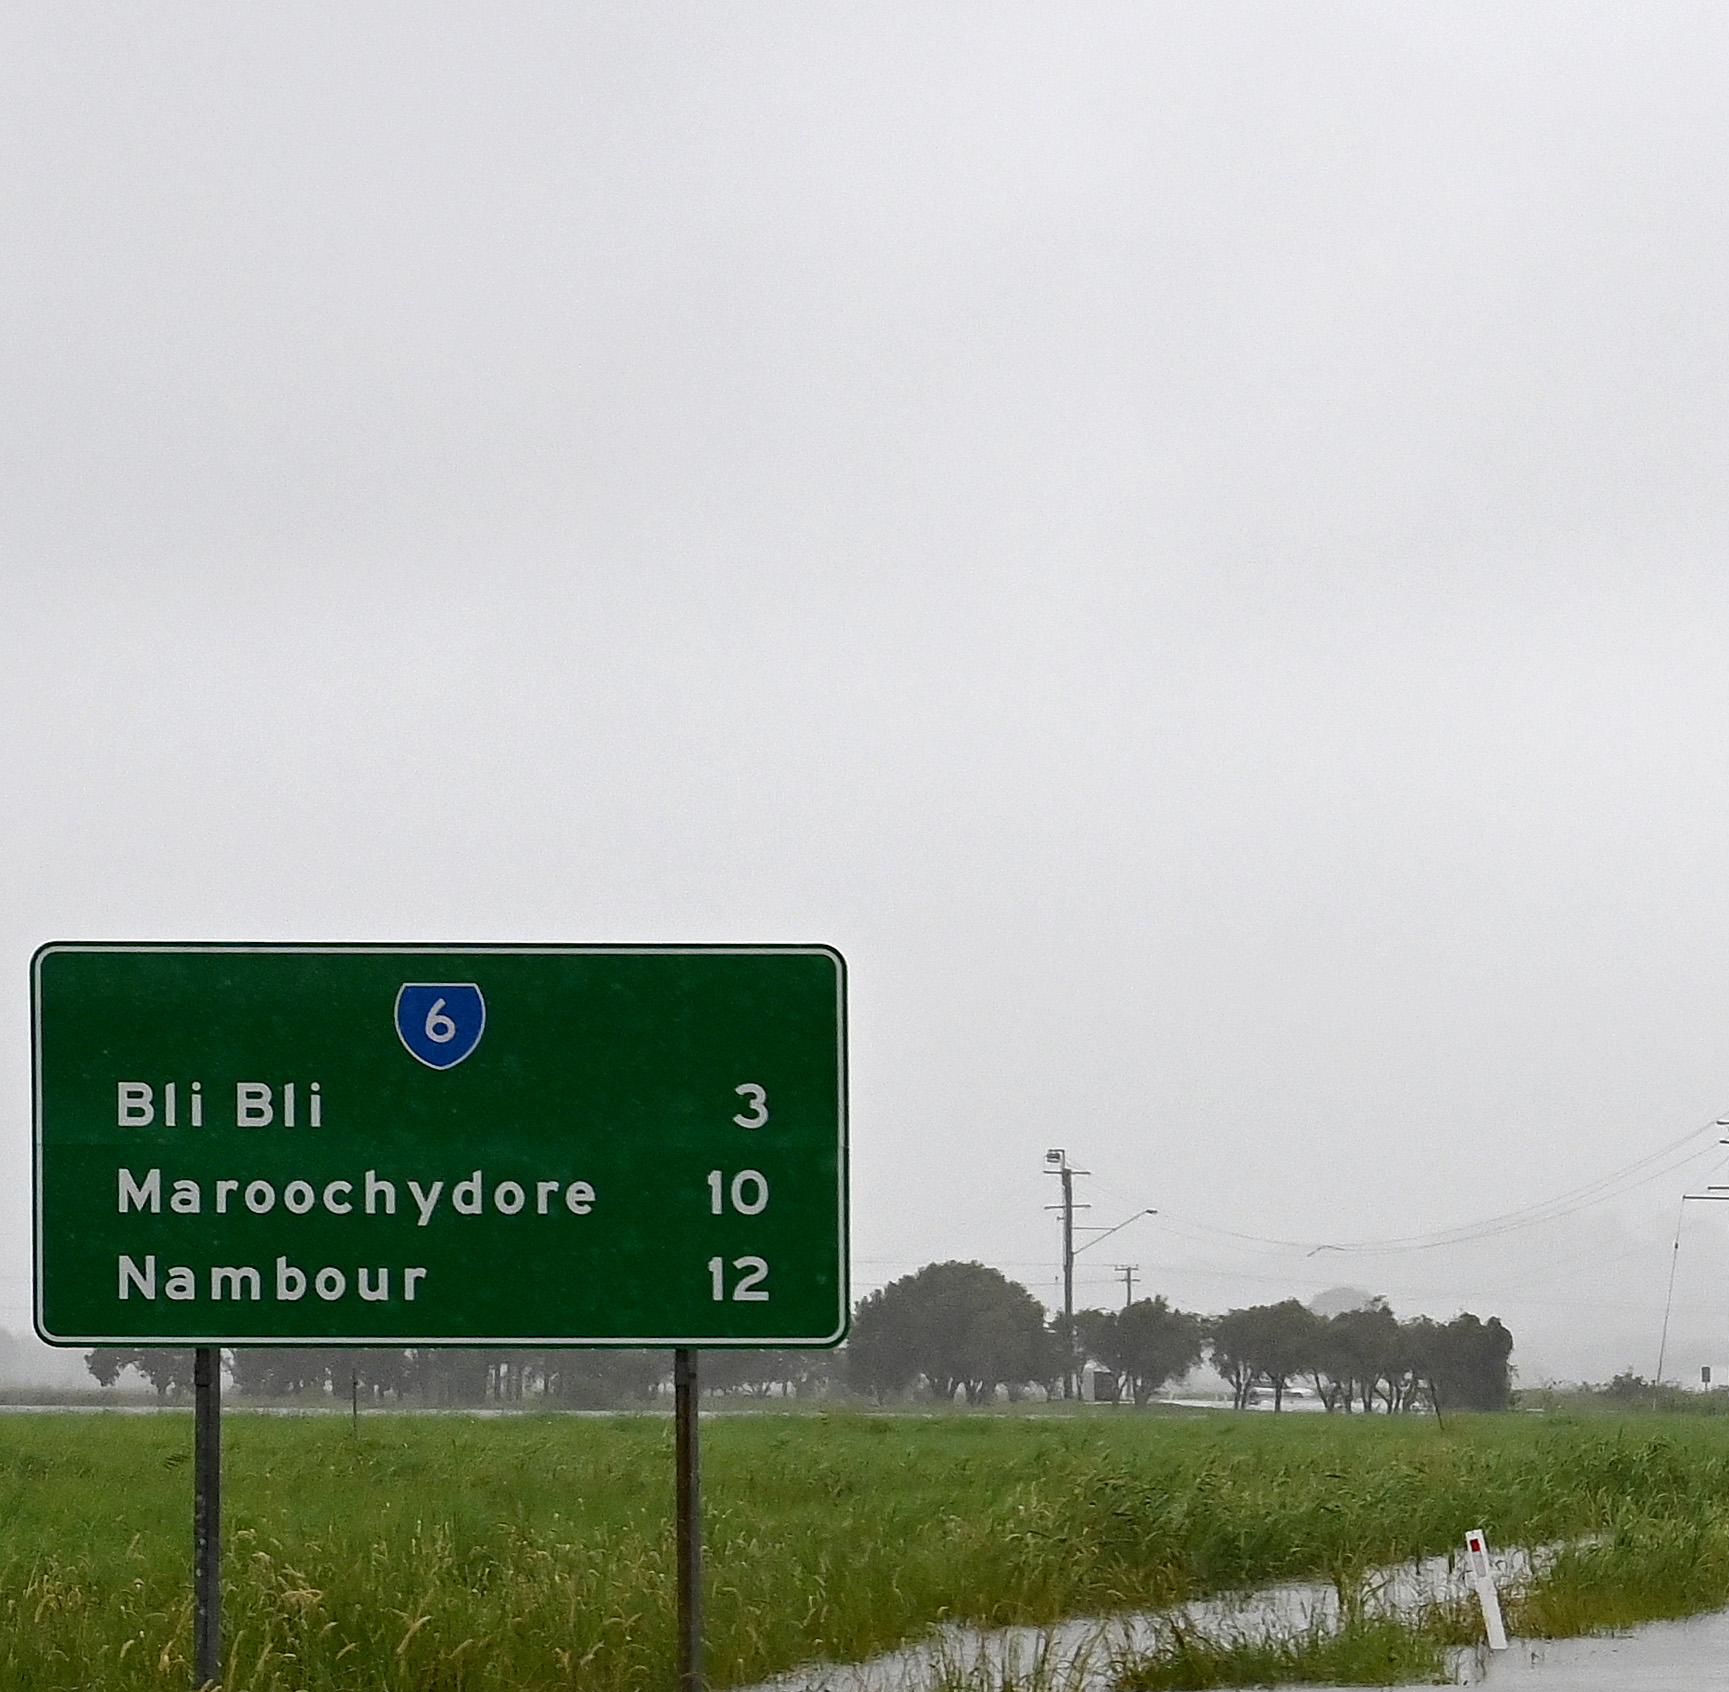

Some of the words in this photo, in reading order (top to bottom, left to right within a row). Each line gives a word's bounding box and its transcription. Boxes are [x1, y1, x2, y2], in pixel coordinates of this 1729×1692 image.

[426, 999, 455, 1042] 6
[118, 1082, 201, 1126] Bli
[237, 1083, 320, 1127] Bli
[734, 1084, 768, 1128] 3
[119, 1169, 595, 1225] Maroochydore
[708, 1170, 768, 1214] 10
[119, 1256, 426, 1300] Nambour
[709, 1257, 768, 1300] 12
